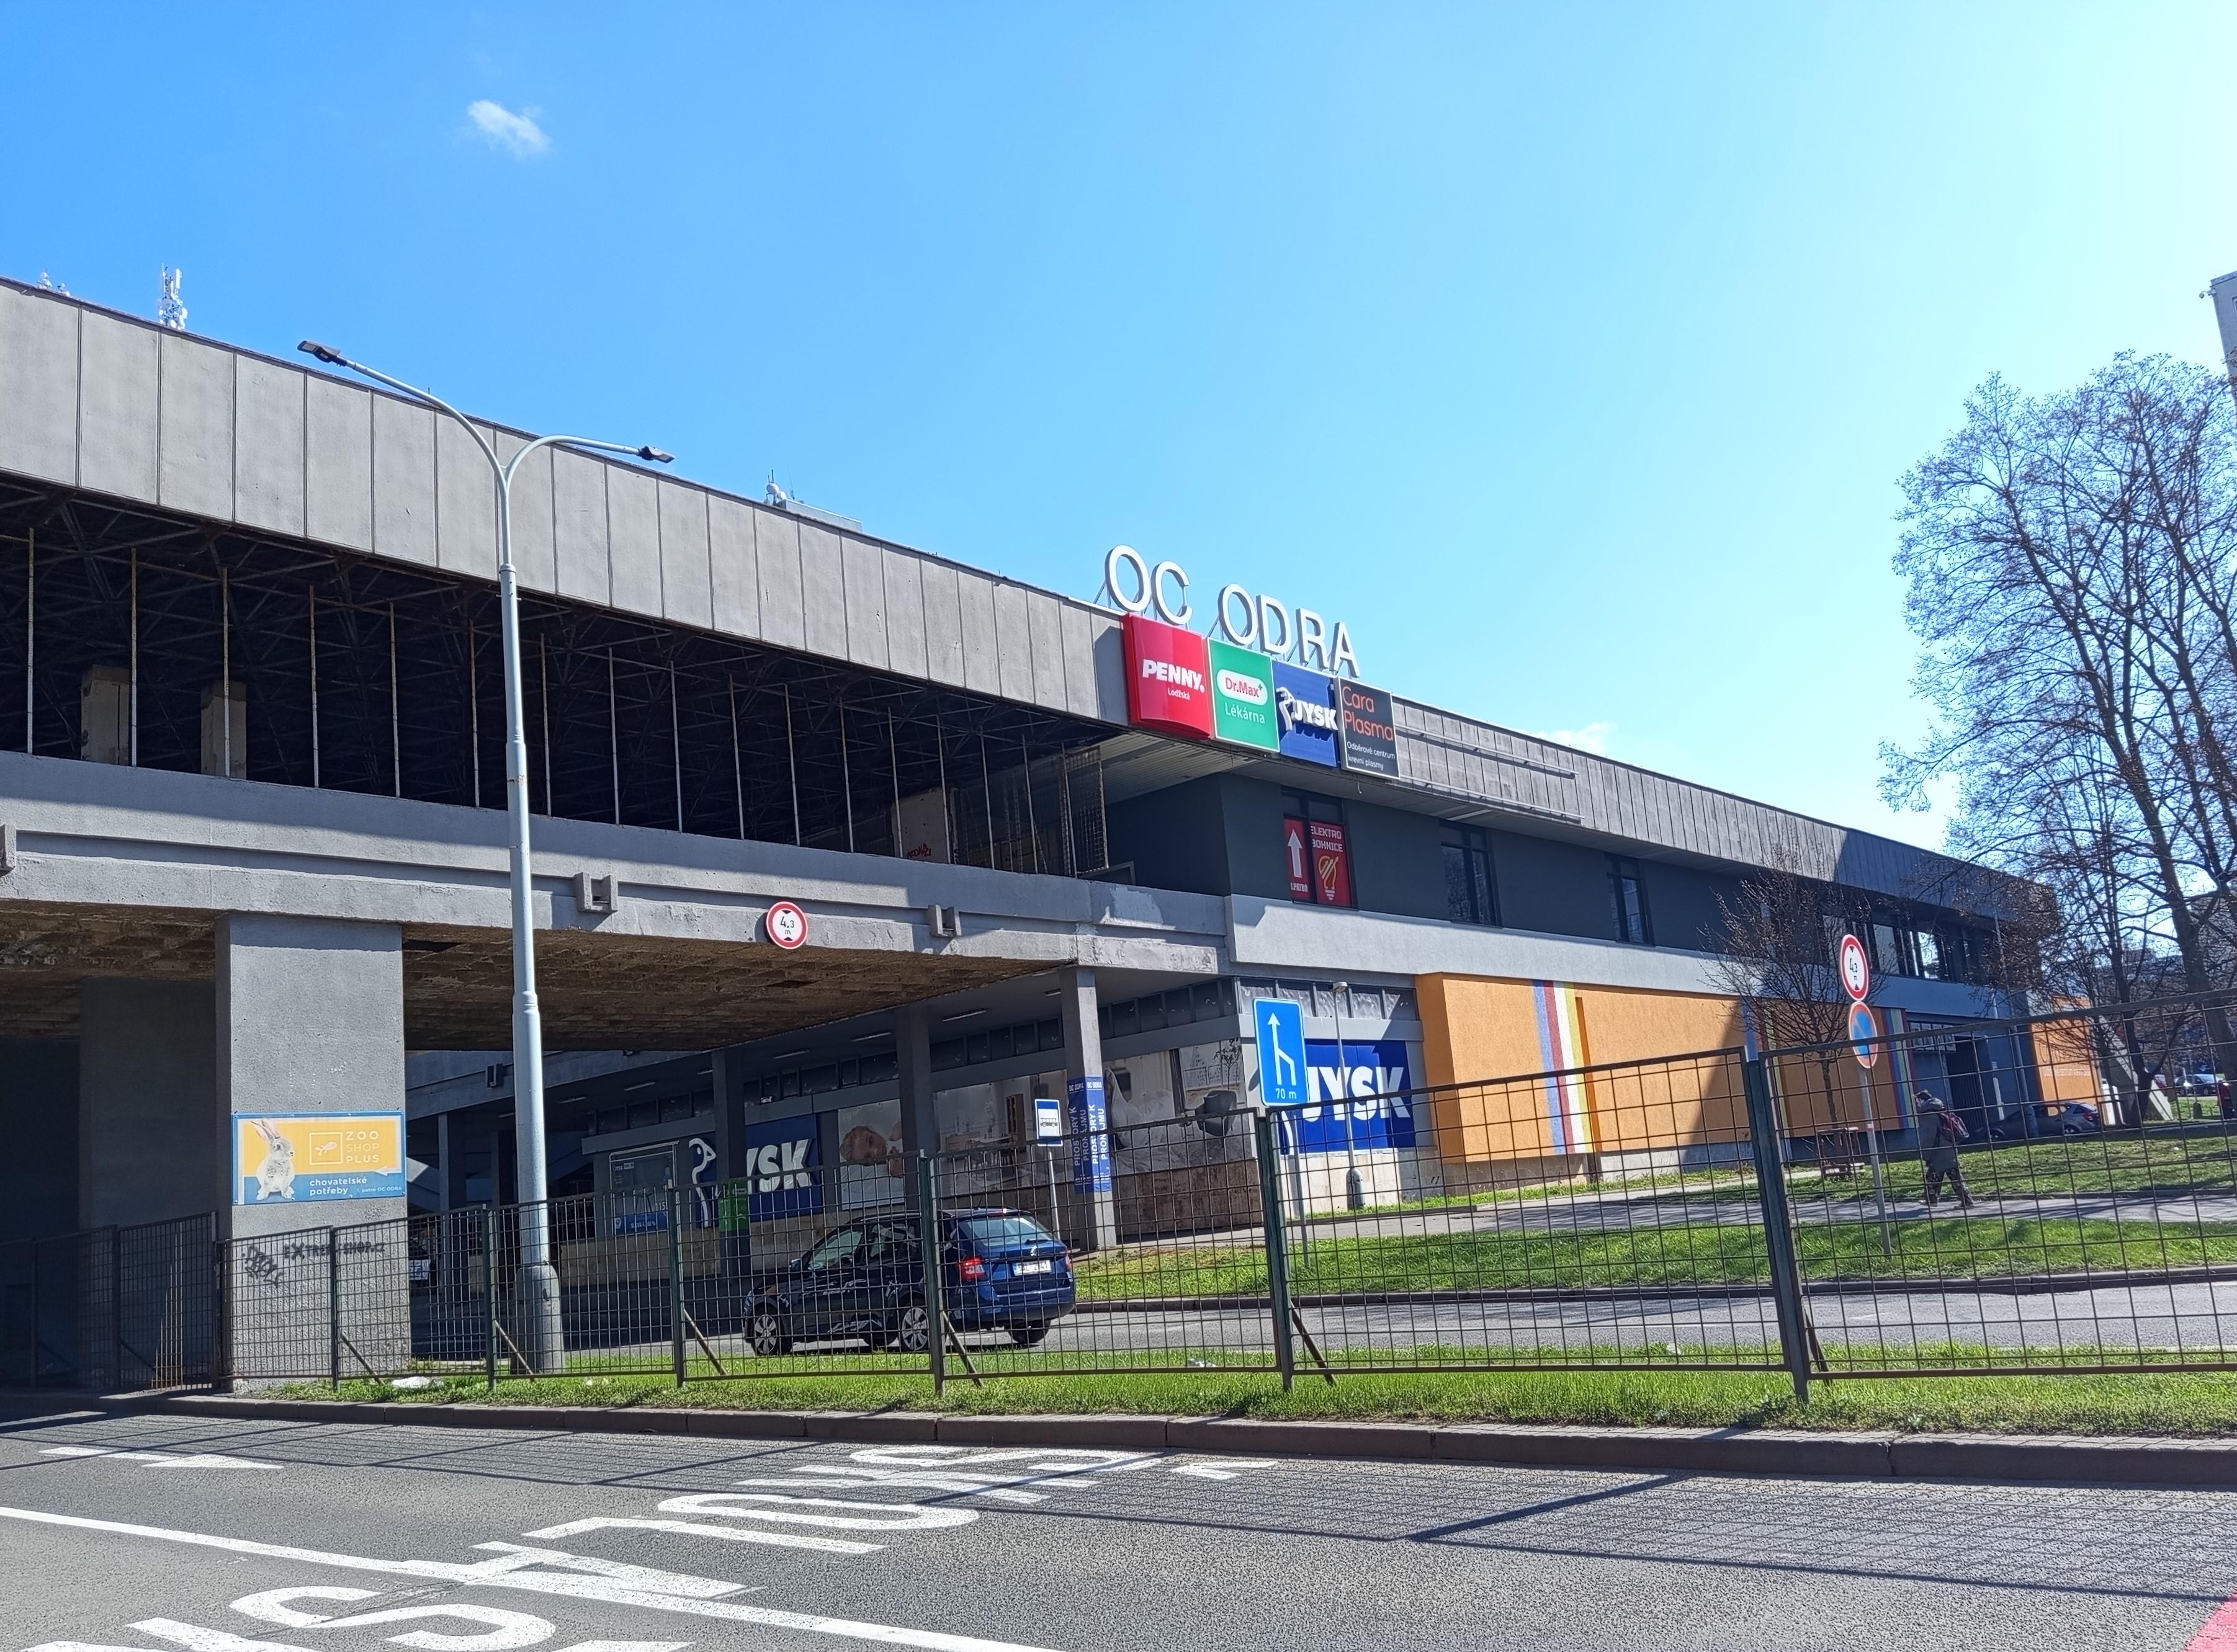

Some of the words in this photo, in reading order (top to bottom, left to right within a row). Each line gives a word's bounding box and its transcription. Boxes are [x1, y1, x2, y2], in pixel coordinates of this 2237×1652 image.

[1105, 545, 1193, 625] OC
[1218, 583, 1360, 678] ODRA
[1142, 659, 1204, 693] PENNY.
[1167, 687, 1190, 700] Lodžská
[1342, 685, 1375, 713] Cara
[1224, 702, 1265, 725] Lékárna
[1293, 699, 1338, 730] JYSK
[1344, 714, 1394, 742] Plasma
[1347, 741, 1373, 754] Odběrové
[1373, 749, 1396, 760] centrum
[1348, 754, 1365, 765] krevní
[1365, 759, 1384, 770] plasmy
[1311, 826, 1342, 839] ELEKTRO
[1311, 838, 1343, 852] BOHNICE
[1275, 1087, 1286, 1099] 70
[1288, 1091, 1297, 1100] m
[1304, 1066, 1410, 1122] JYSK
[1069, 1106, 1077, 1114] K
[346, 1130, 379, 1140] ZOO
[1072, 1117, 1080, 1166] PROSORY
[1089, 1115, 1099, 1164] PROSORY
[346, 1143, 380, 1152] SHOP
[346, 1154, 380, 1164] PLUS
[310, 1176, 367, 1187] chovatelské
[310, 1185, 348, 1197] potřeby
